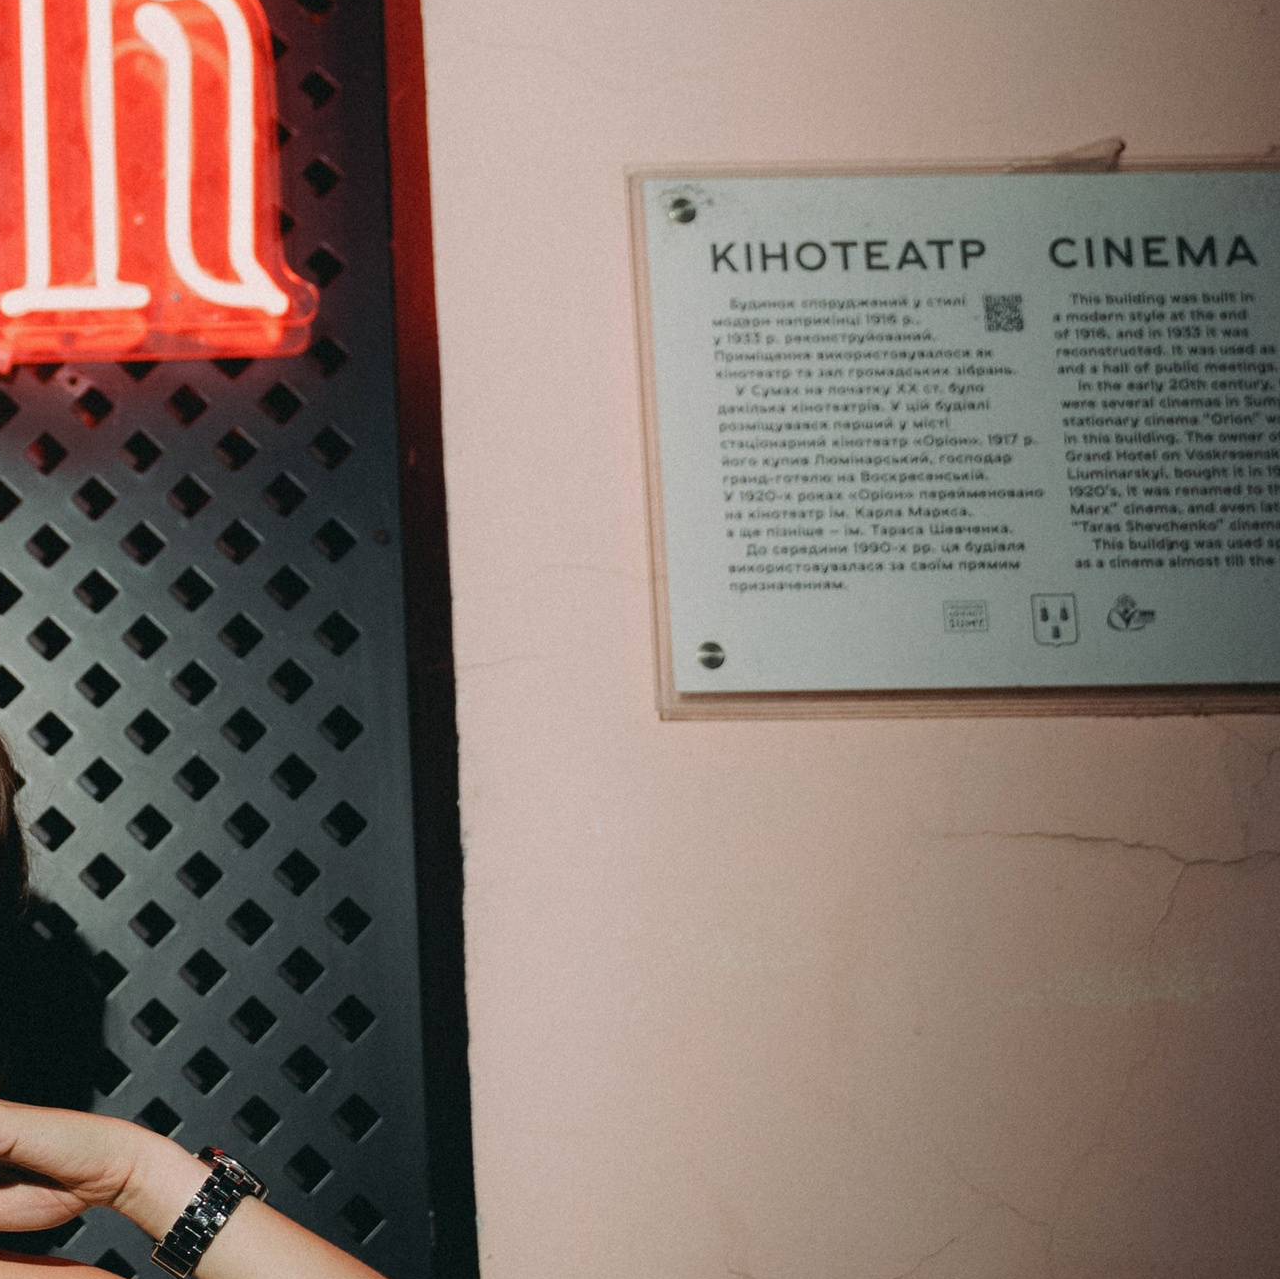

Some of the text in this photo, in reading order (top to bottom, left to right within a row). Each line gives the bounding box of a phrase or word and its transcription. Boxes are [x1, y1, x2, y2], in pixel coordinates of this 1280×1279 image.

[709, 238, 987, 273] КІНОТЕАТР
[1048, 234, 1259, 269] CINEMA
[1072, 290, 1254, 308] This building was built in
[1066, 308, 1123, 322] modern
[1128, 308, 1165, 324] style
[1170, 309, 1185, 321] at
[1190, 307, 1215, 321] the
[1219, 307, 1248, 320] end
[1054, 326, 1070, 340] of
[1116, 326, 1143, 339] and
[1148, 326, 1162, 339] in
[1221, 328, 1249, 338] was
[1187, 346, 1215, 356] was
[1219, 342, 1254, 355] used
[1259, 346, 1275, 355] as
[1057, 361, 1085, 374] and
[1102, 360, 1129, 374] hall
[1133, 360, 1150, 373] of
[1154, 360, 1200, 376] public
[1096, 378, 1122, 391] the
[1126, 378, 1164, 394] early
[1169, 377, 1206, 391] 20th
[1060, 399, 1096, 409] were
[1100, 395, 1155, 409] several
[1159, 394, 1221, 408] cinemas
[1225, 394, 1240, 407] in
[1061, 413, 1139, 430] stationary
[1144, 412, 1199, 426] cinema
[1063, 431, 1077, 444] in
[1082, 431, 1110, 444] this
[1185, 430, 1214, 443] The
[1217, 433, 1263, 443] owner
[1065, 448, 1111, 462] Grand
[1116, 448, 1157, 461] Hotel
[1161, 451, 1181, 461] on
[1174, 465, 1228, 482] bought
[1232, 465, 1244, 478] it
[1248, 465, 1262, 478] in
[1126, 484, 1138, 497] it
[1142, 487, 1170, 496] was
[1174, 483, 1242, 496] renamed
[1247, 484, 1264, 496] to
[1187, 501, 1215, 514] and
[1219, 504, 1255, 513] even
[1093, 537, 1123, 550] This
[1128, 536, 1190, 553] building
[1193, 540, 1222, 549] was
[1227, 536, 1262, 549] used
[1075, 558, 1091, 568] as
[1109, 554, 1164, 568] cinema
[1168, 554, 1220, 567] almost
[1249, 553, 1275, 567] the
